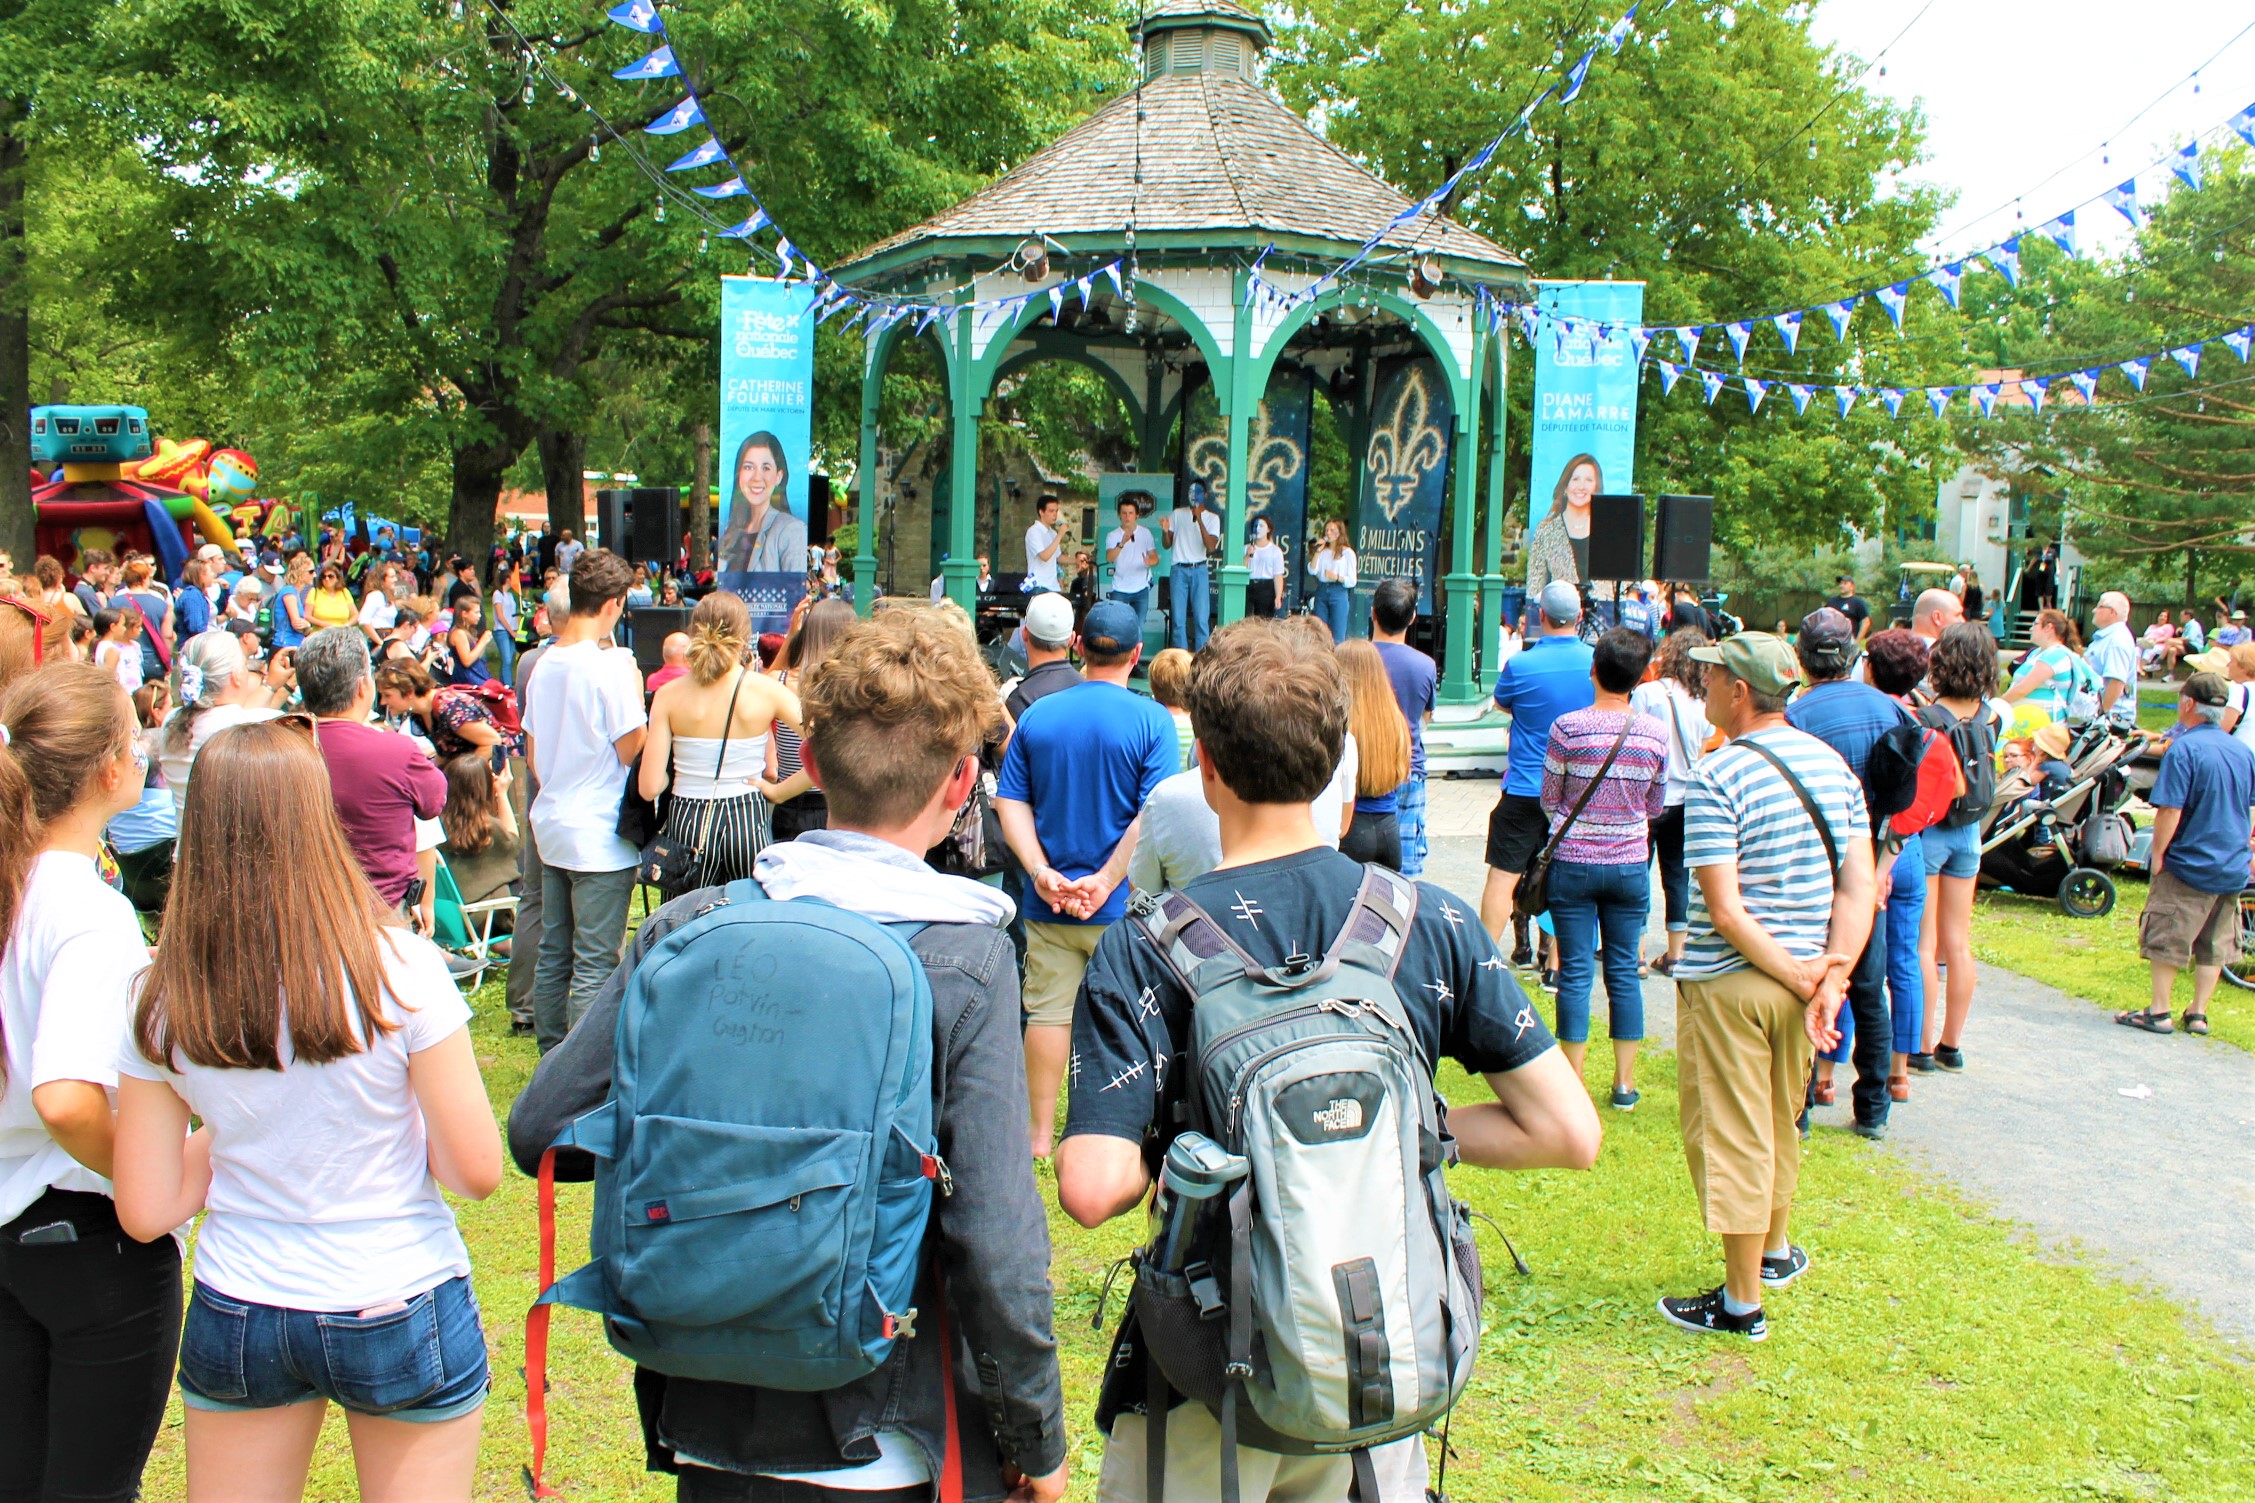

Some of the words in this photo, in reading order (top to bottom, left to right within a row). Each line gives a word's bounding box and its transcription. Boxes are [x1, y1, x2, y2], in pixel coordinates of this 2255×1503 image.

[743, 310, 786, 332] Fête
[736, 329, 799, 344] nationale
[736, 341, 798, 360] Québec
[727, 378, 805, 394] CATHERINE
[727, 391, 805, 406] FOURNIER
[1542, 392, 1593, 407] DIANE
[1542, 405, 1630, 421] LAMARRE
[1541, 422, 1578, 432] DÉPUTÉE
[1579, 423, 1590, 432] DE
[1591, 423, 1629, 432] TAILLON
[1360, 525, 1367, 550] 8
[1367, 529, 1426, 553] MILLIONS
[713, 938, 777, 984] LÉO
[1328, 1099, 1348, 1111] THE
[1312, 1108, 1347, 1123] NORTH
[1323, 1119, 1347, 1132] FACE
